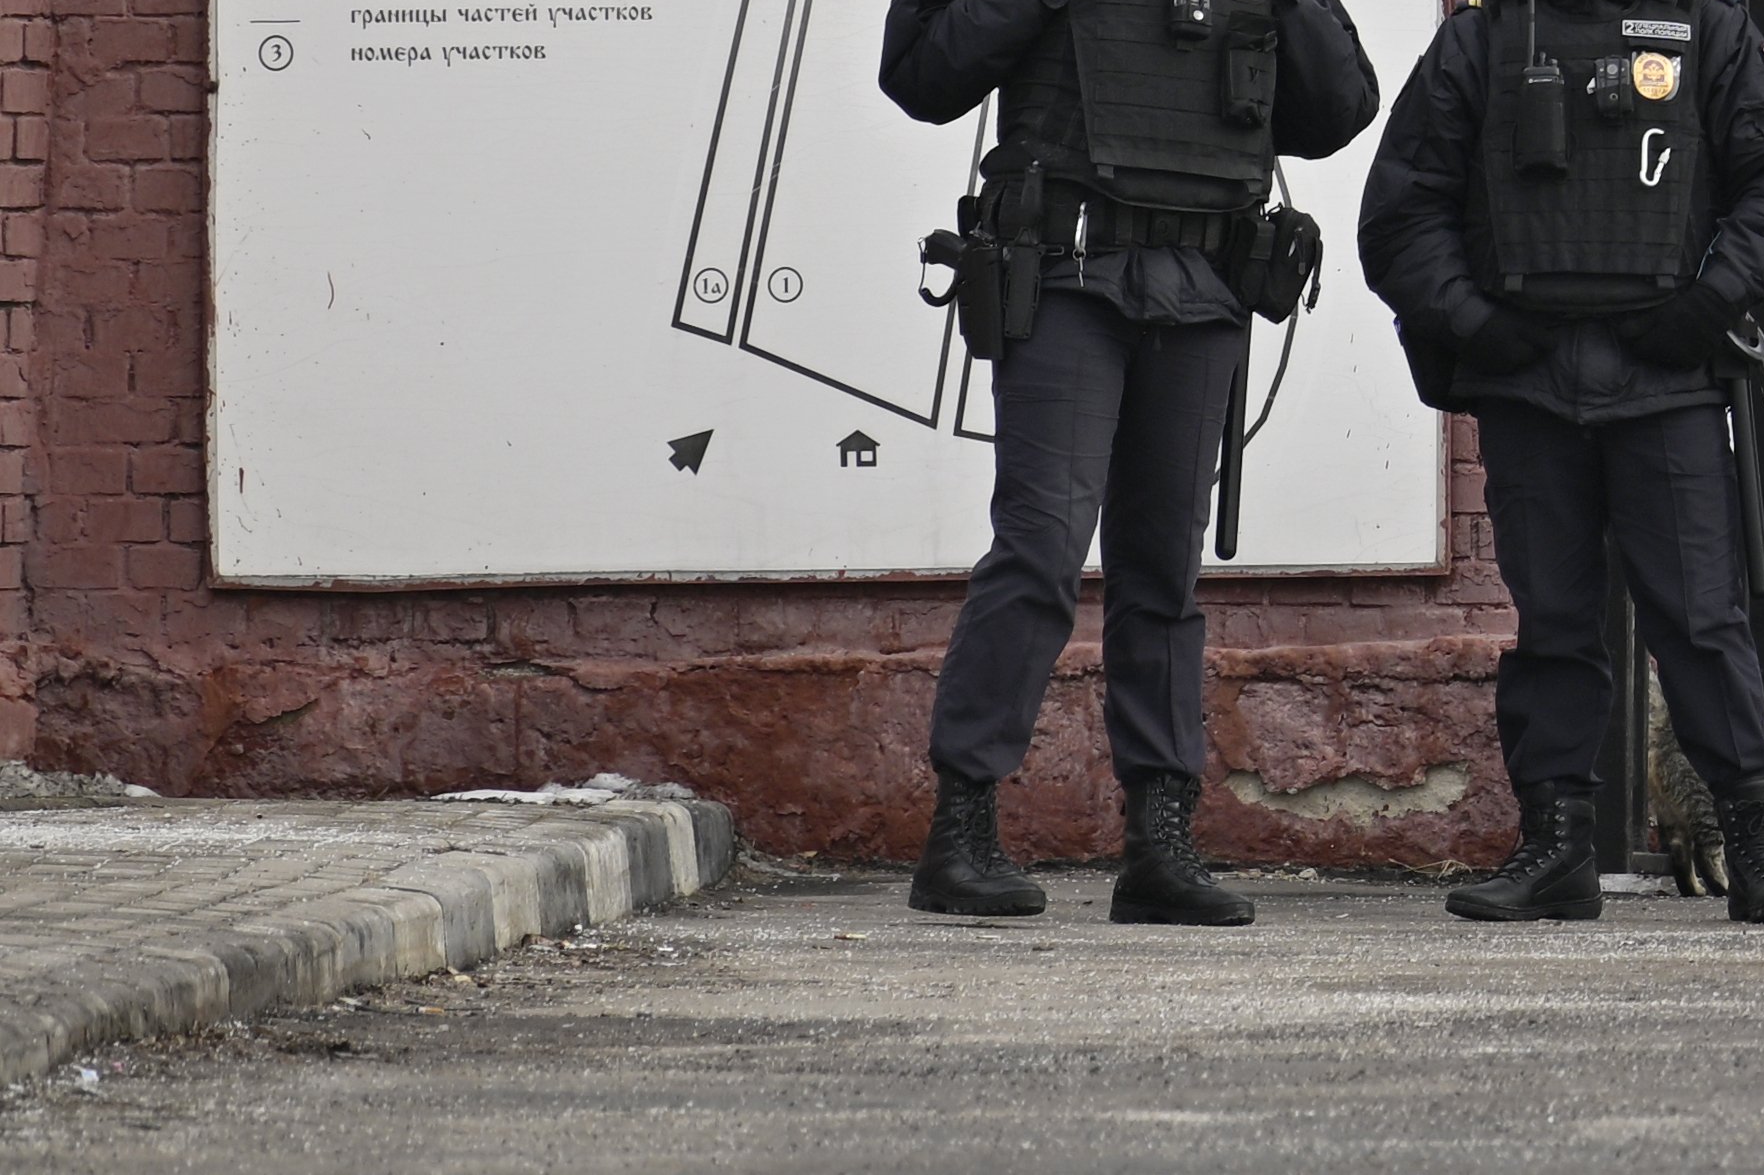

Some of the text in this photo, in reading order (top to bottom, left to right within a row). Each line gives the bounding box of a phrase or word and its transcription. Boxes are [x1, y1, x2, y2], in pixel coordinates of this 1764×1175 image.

[350, 4, 653, 30] границы частей участков
[270, 43, 283, 64] 3
[350, 43, 547, 67] номера участков
